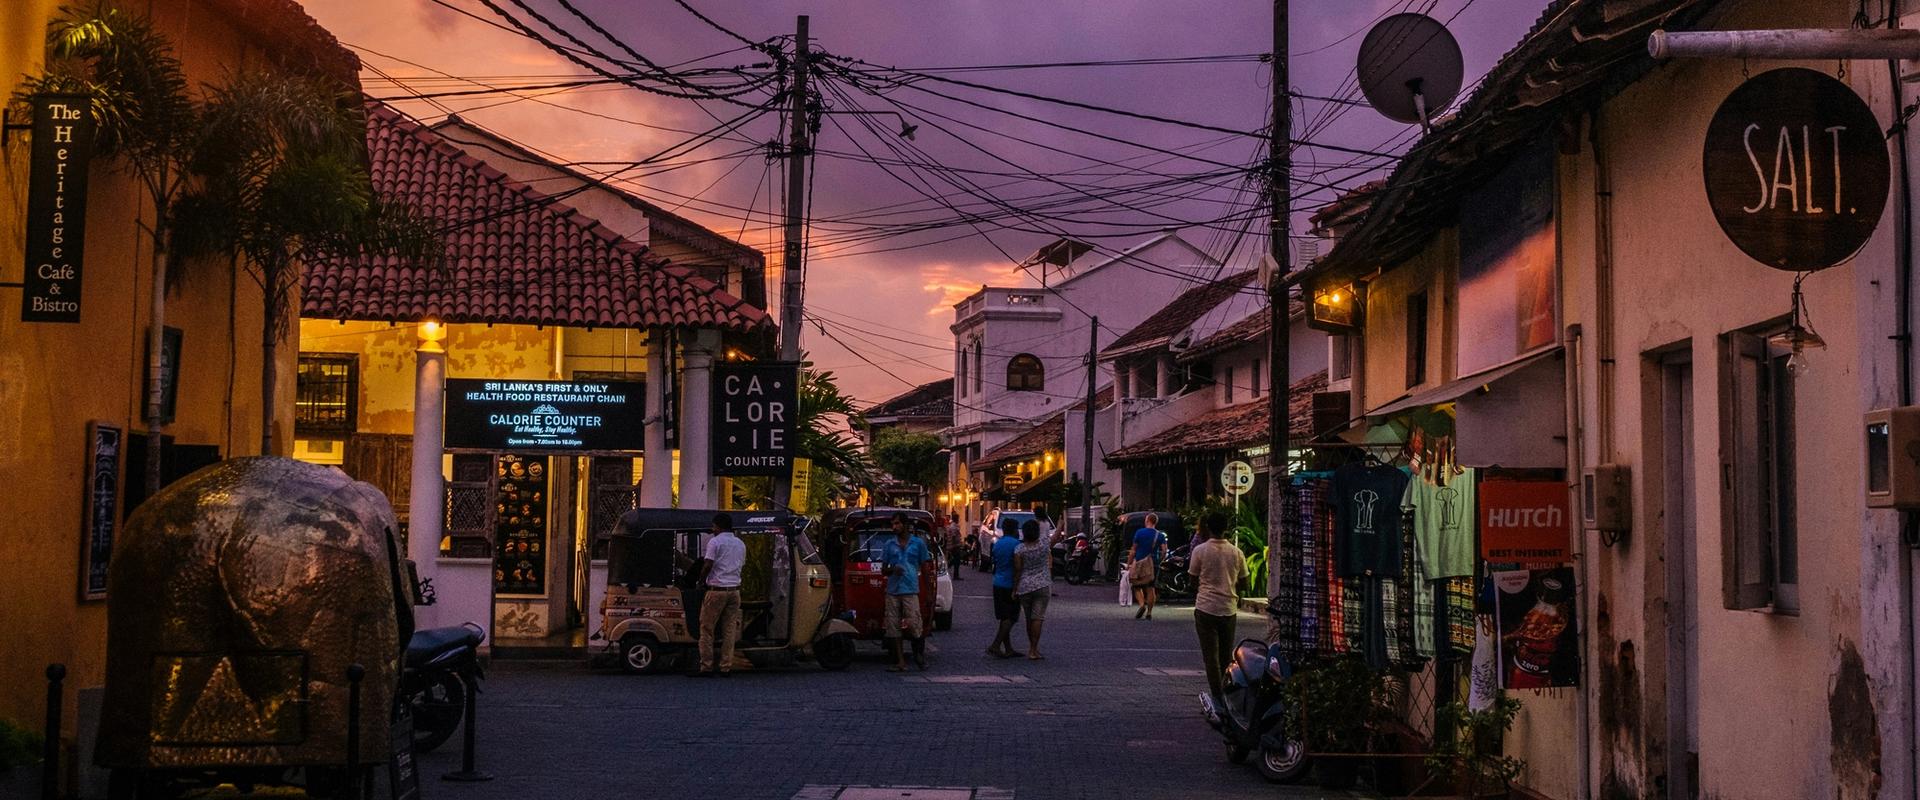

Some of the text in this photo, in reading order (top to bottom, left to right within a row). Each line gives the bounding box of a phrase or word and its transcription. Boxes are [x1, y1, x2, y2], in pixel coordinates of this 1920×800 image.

[49, 104, 81, 120] The
[1743, 123, 1857, 214] SALT.
[52, 126, 73, 259] Heritage
[38, 264, 75, 280] Café
[49, 283, 62, 295] &
[32, 296, 78, 313] Bistro
[485, 383, 609, 393] SRI LANKA'S FIRST & ONLY
[466, 392, 626, 403] HEALTH FOOD RESTAURANT CHAIN
[490, 415, 601, 427] CALORIE COUNTER
[514, 425, 524, 433] Eat
[508, 438, 522, 446] Open
[725, 456, 785, 467] COUNTER
[1489, 548, 1563, 558] BEST INTERNET
[1521, 660, 1540, 671] zero
